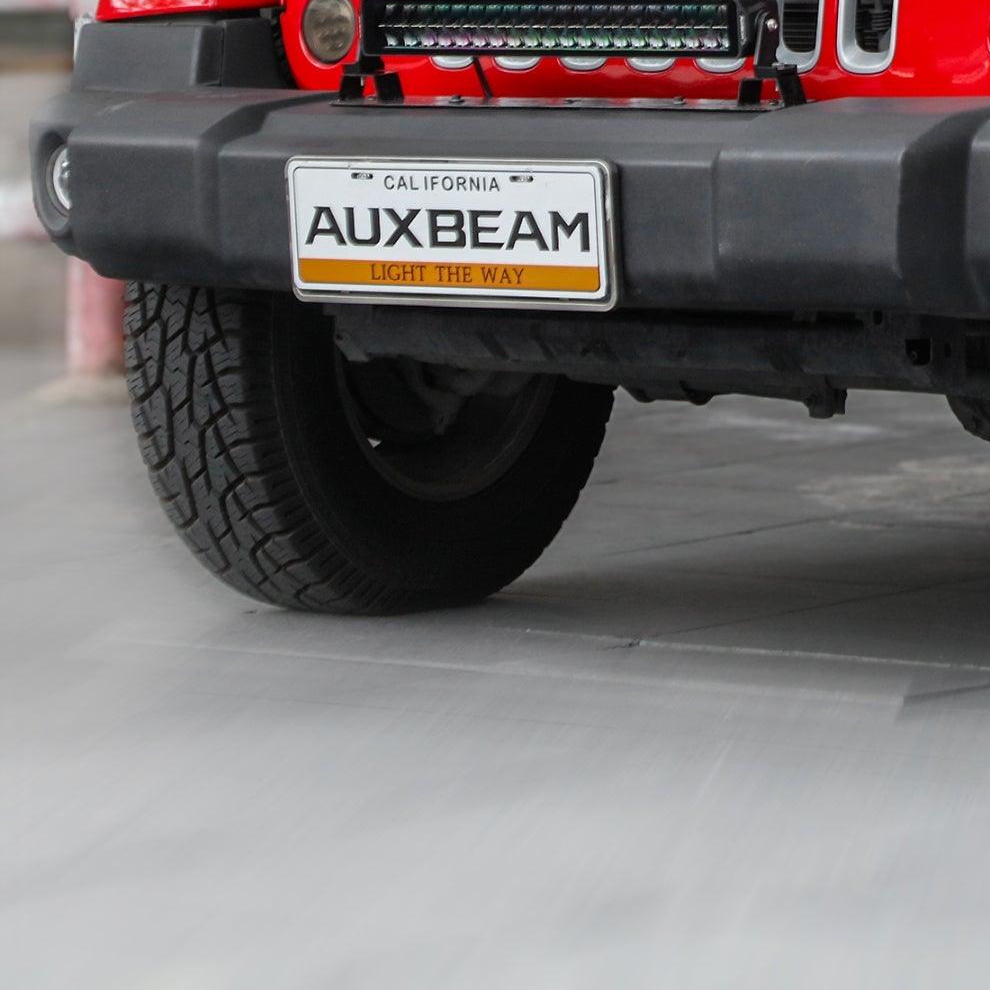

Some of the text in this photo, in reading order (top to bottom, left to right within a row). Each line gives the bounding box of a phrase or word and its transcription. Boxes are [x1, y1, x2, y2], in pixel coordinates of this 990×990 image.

[383, 175, 501, 192] CALIFORNIA
[305, 206, 590, 252] AUXBEAM
[370, 264, 524, 285] LIGHT THE WAY
